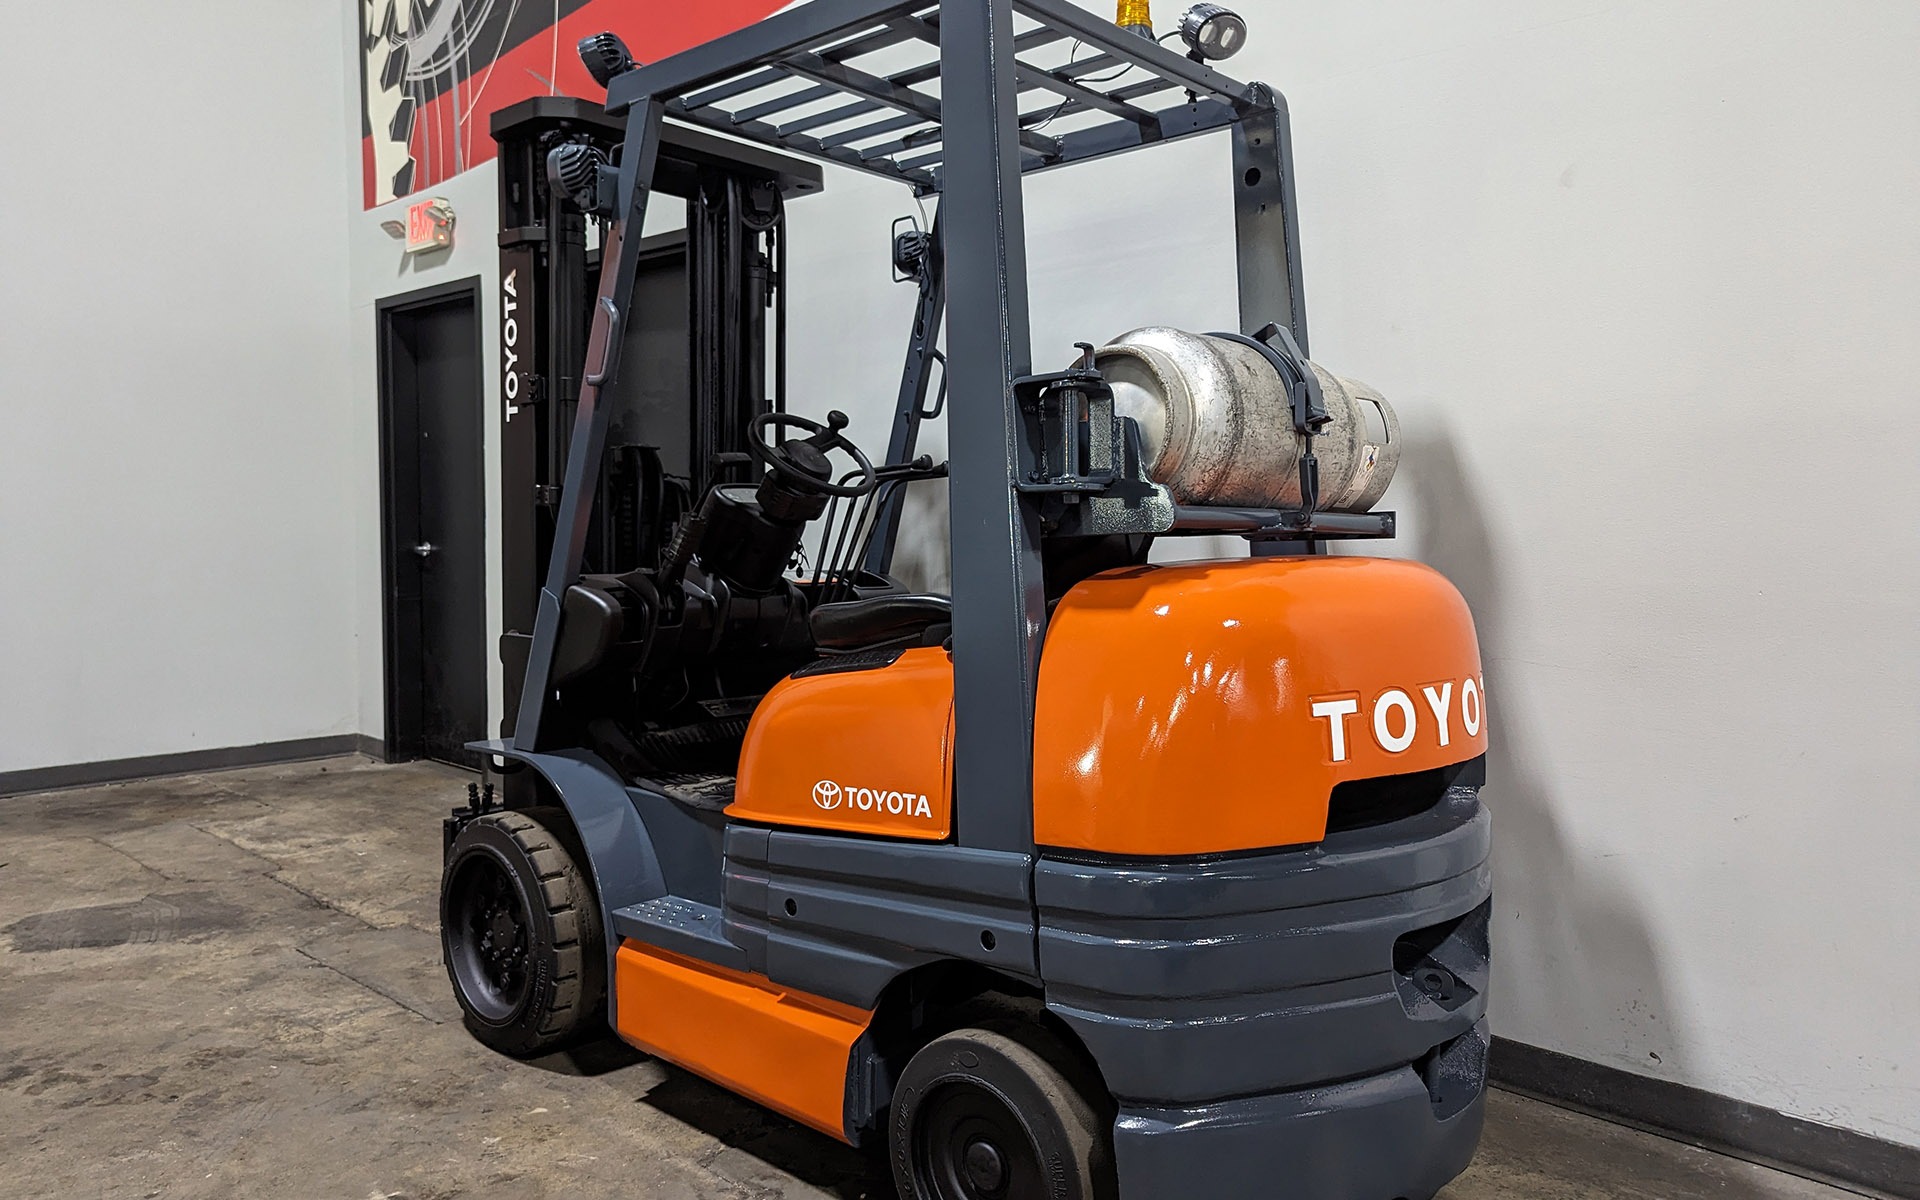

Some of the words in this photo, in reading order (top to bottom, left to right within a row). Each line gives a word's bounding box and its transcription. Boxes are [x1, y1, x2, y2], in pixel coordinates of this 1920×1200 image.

[504, 268, 519, 423] TOYOTA
[1312, 675, 1486, 762] TOYO
[844, 786, 933, 819] TOYOTA
